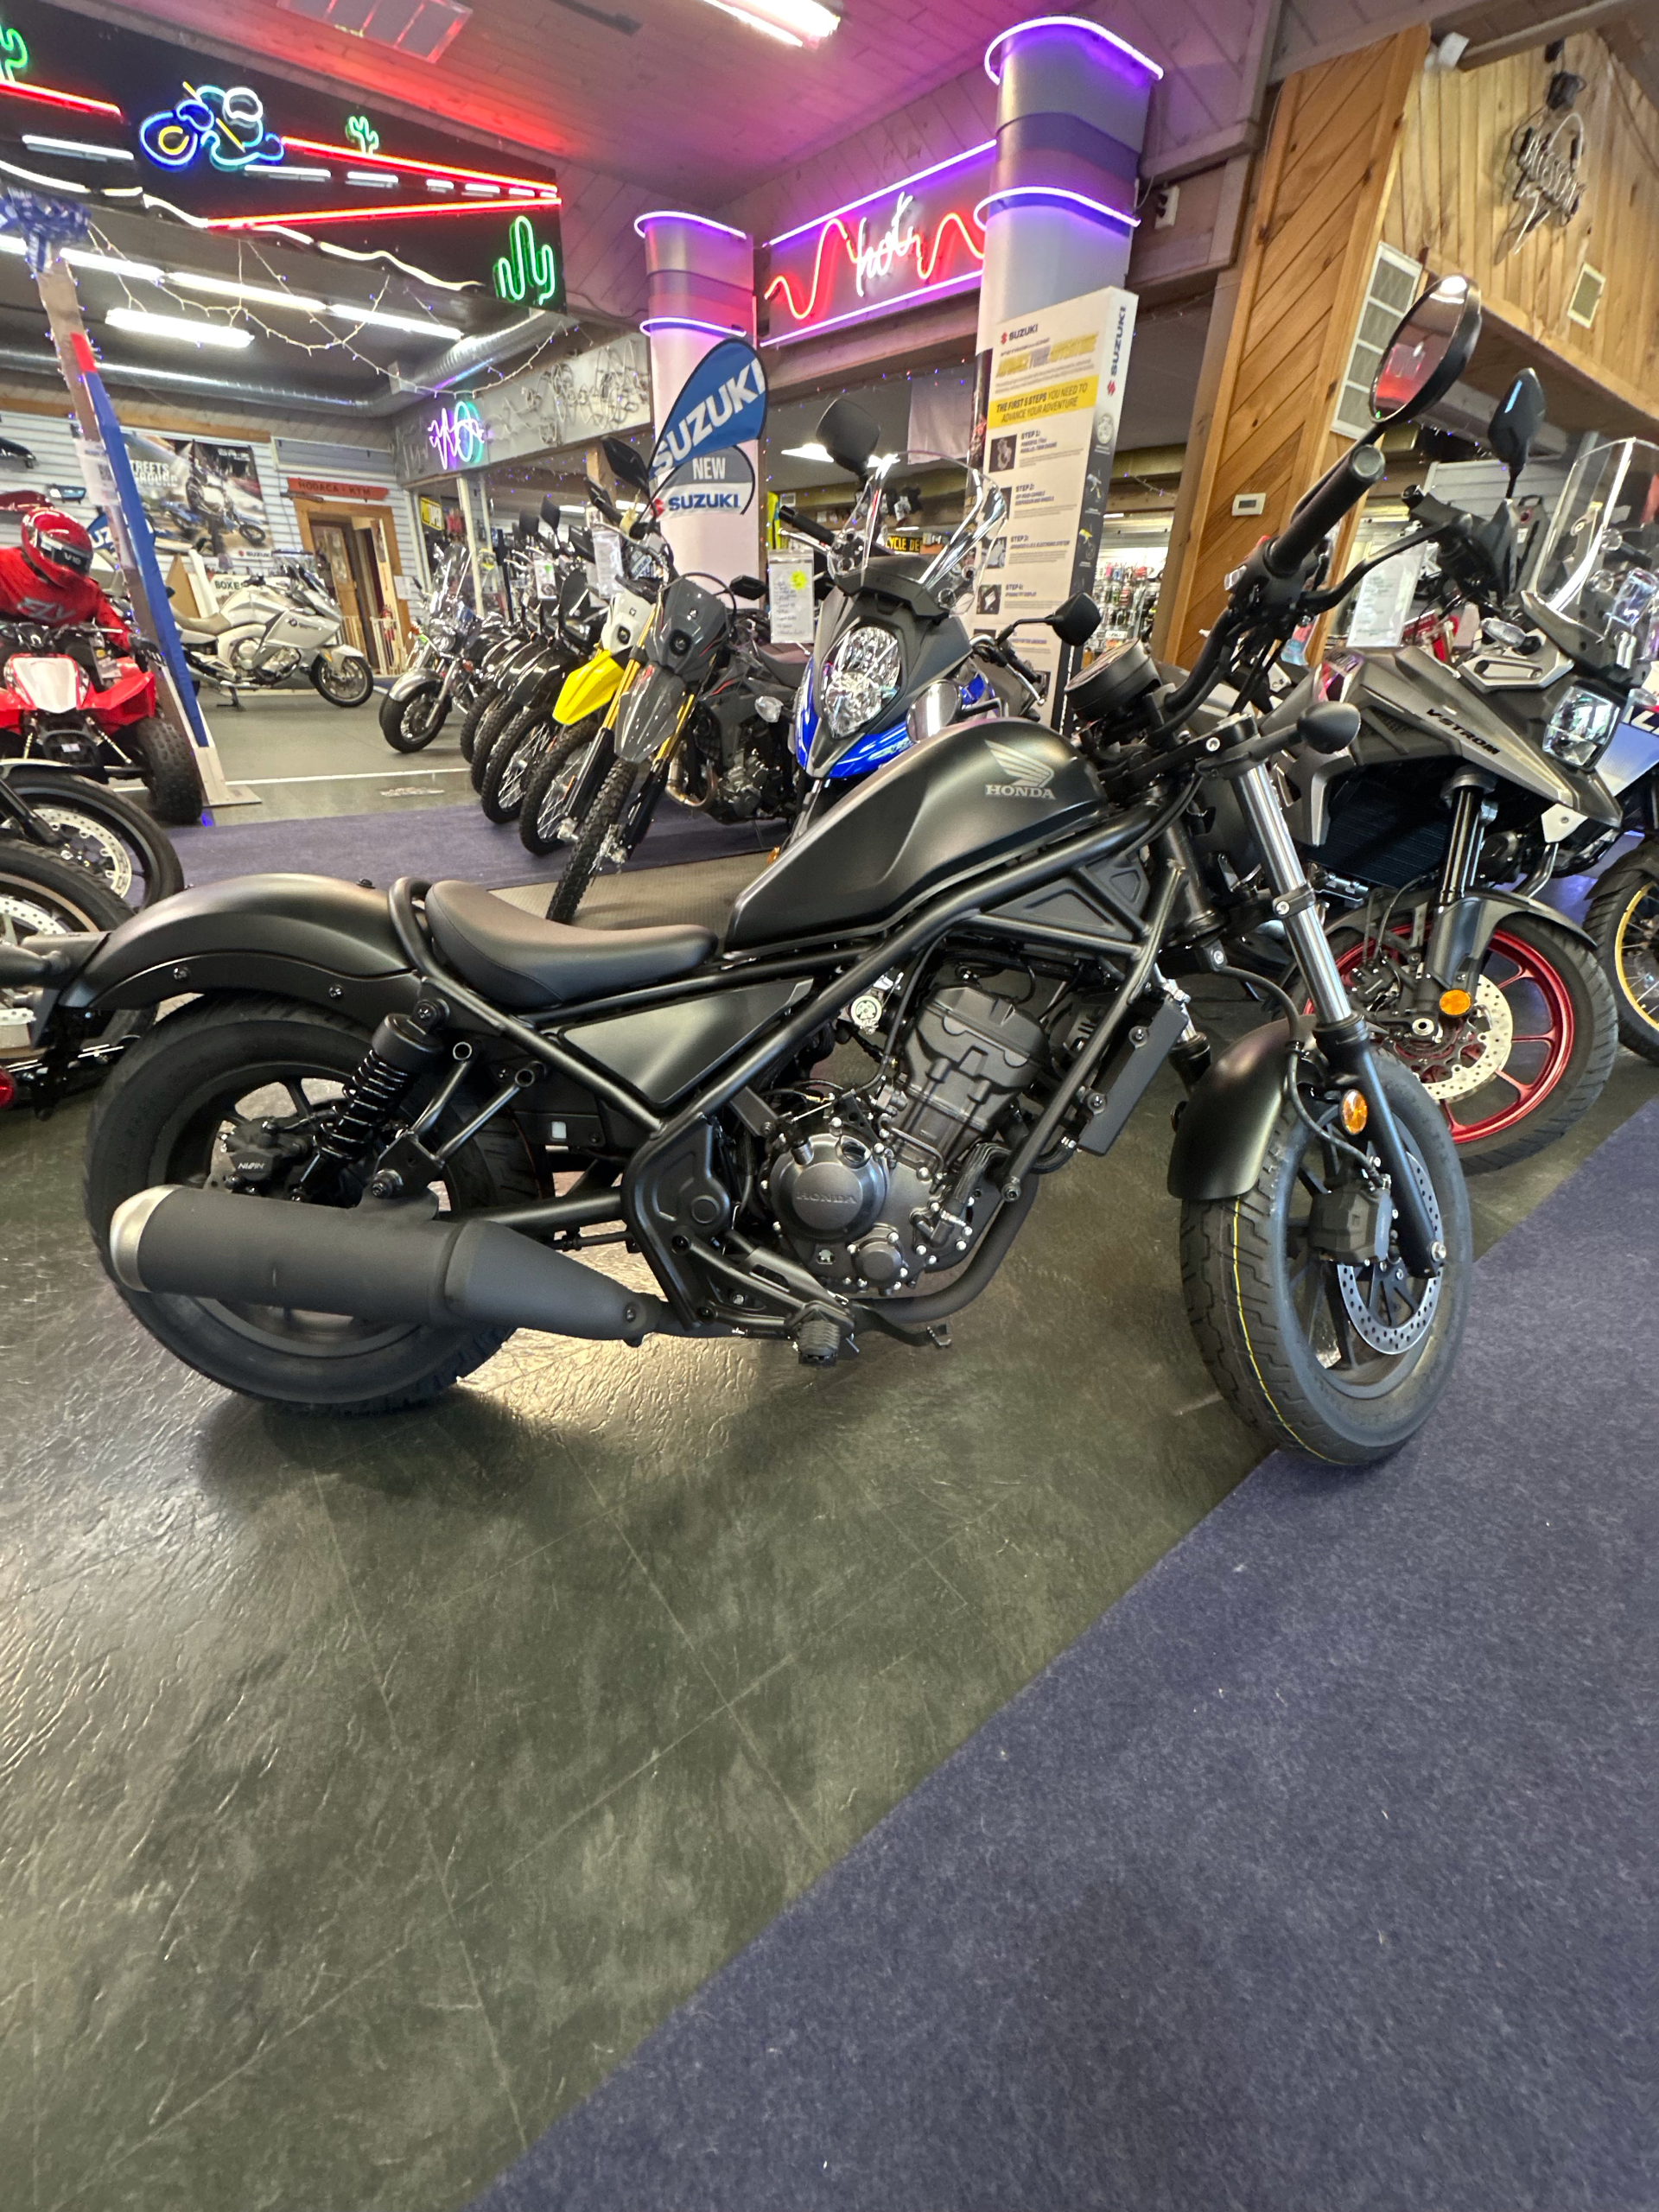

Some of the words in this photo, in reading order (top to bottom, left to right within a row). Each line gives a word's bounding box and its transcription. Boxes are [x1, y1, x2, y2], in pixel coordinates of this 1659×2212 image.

[1009, 324, 1039, 341] SUZUKI
[1111, 306, 1127, 377] SUZUKI
[996, 402, 1007, 413] THE
[1007, 398, 1025, 411] FIRST
[1028, 392, 1047, 405] STEPS
[1047, 389, 1062, 400] YOU
[1060, 385, 1079, 397] NEED
[1077, 382, 1089, 393] TO
[652, 358, 766, 477] SUZUKI
[1001, 408, 1027, 423] ADVANCE
[1027, 404, 1044, 416] YOUR
[1042, 396, 1079, 413] ADVENTURE
[1021, 430, 1035, 440] STEP
[130, 460, 169, 474] TREETS
[692, 457, 727, 480] NEW
[348, 486, 372, 496] KTM
[668, 493, 740, 512] SUZUKI
[885, 536, 906, 550] CYCLE
[214, 580, 243, 591] BOXE
[1427, 709, 1501, 755] V-STROM
[985, 784, 1056, 800] HONDA
[796, 1191, 858, 1205] HONDA
